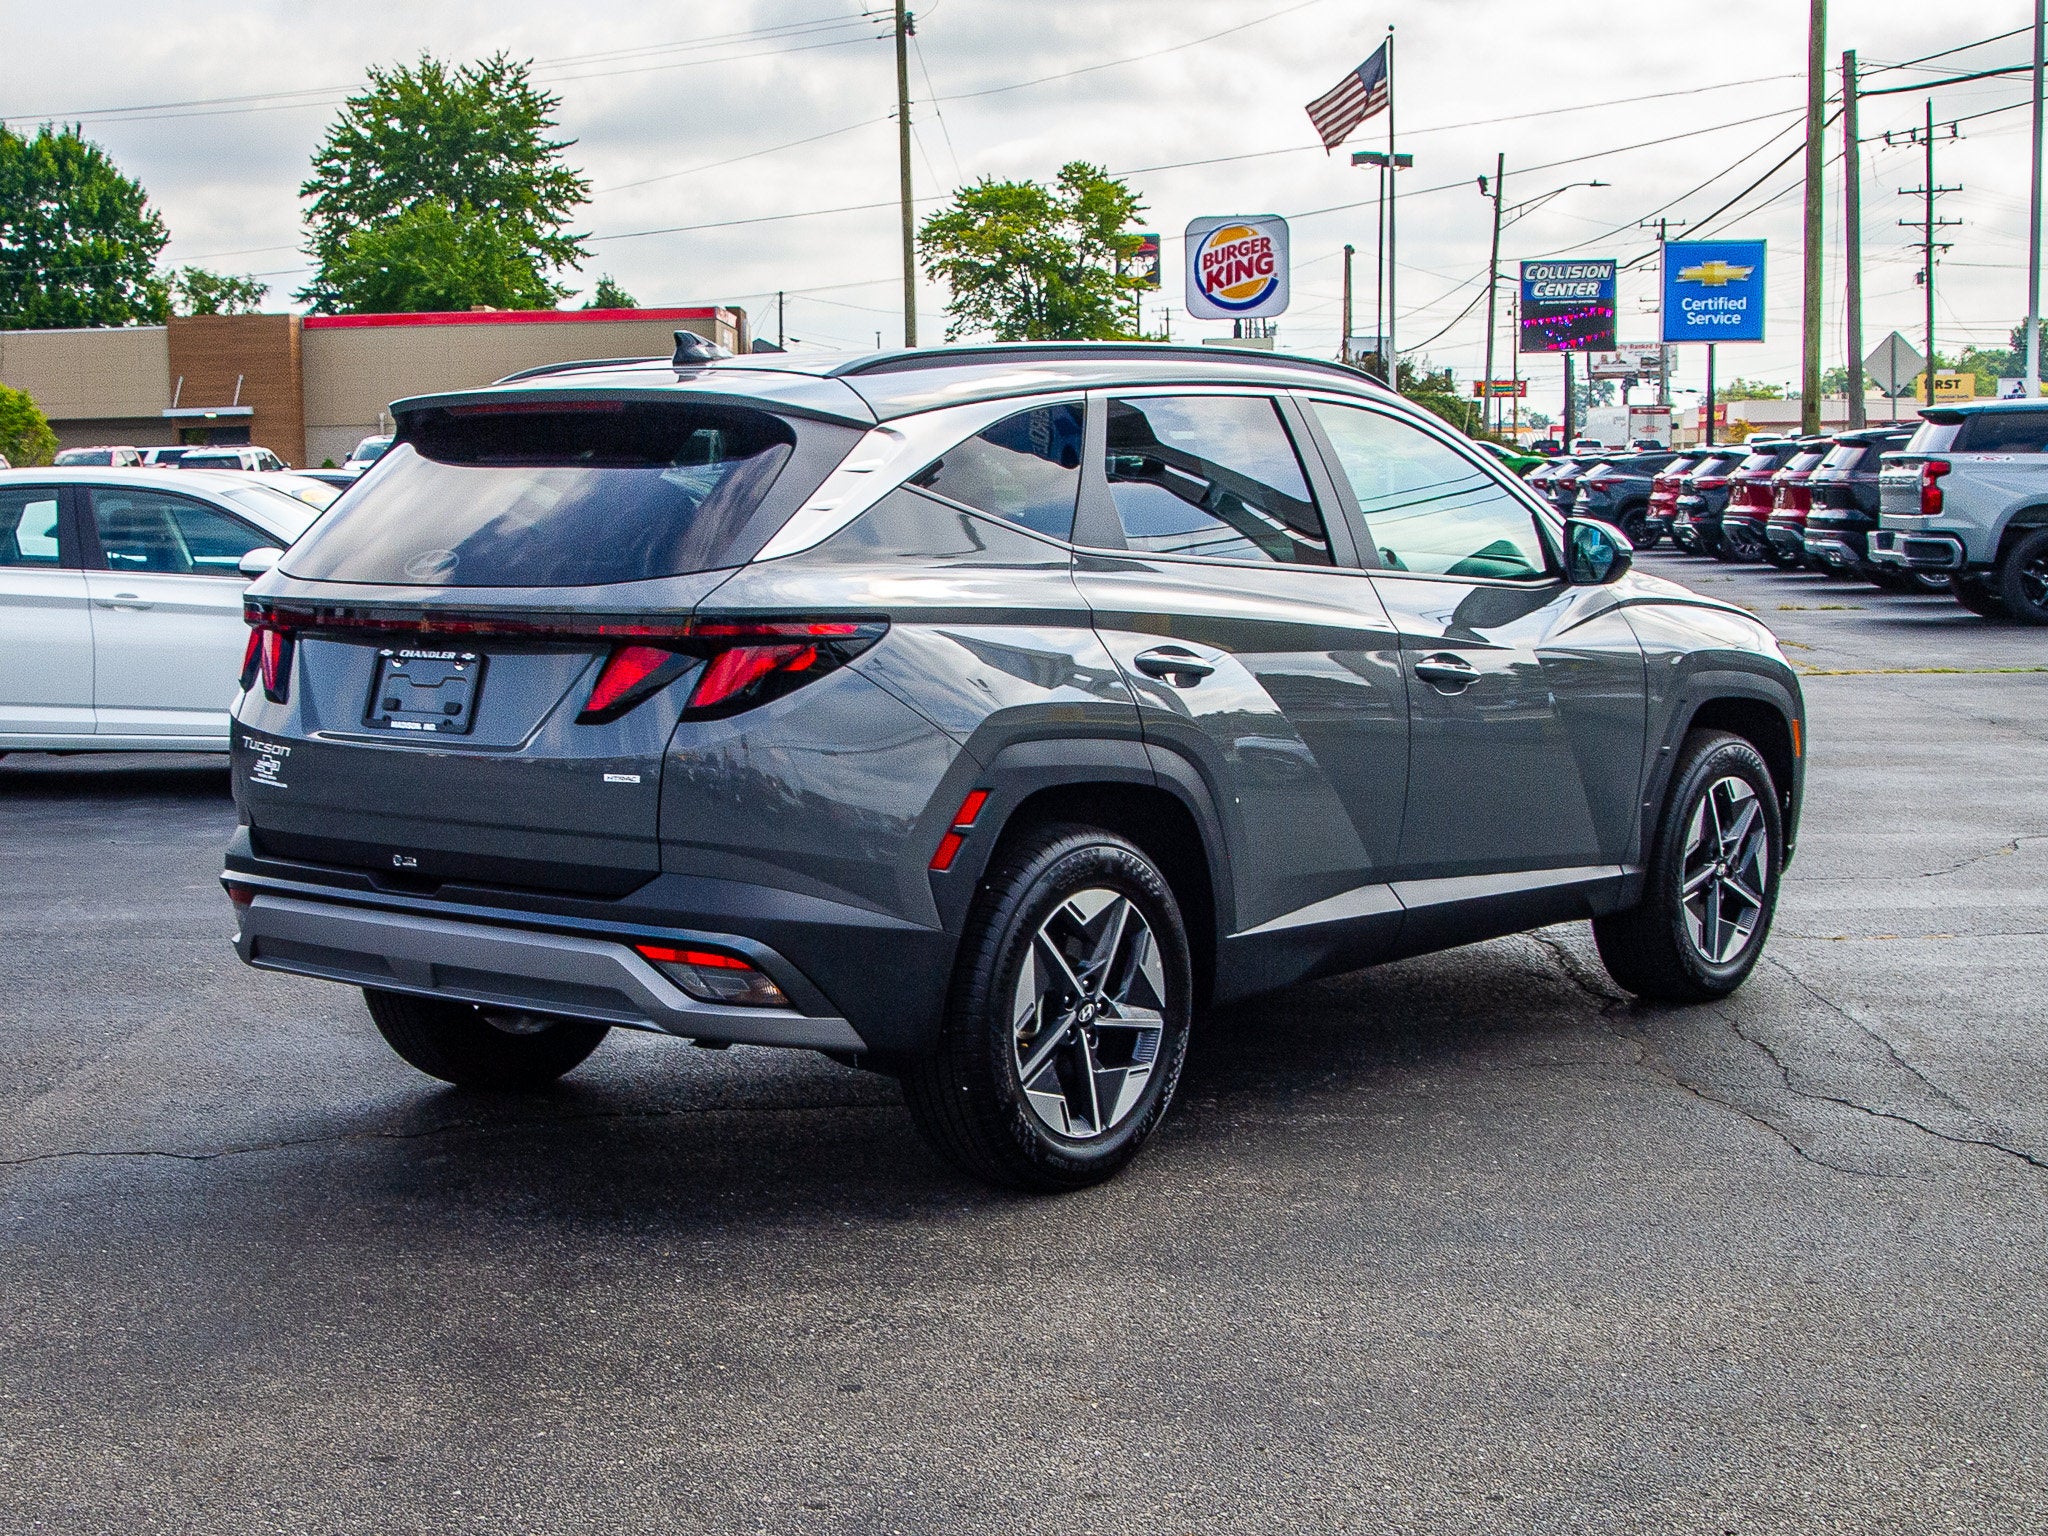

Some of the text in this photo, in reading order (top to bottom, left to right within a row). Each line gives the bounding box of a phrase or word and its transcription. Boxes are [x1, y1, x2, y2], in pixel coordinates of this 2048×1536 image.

[1203, 237, 1271, 270] BURGER
[1206, 252, 1274, 293] KING
[1524, 265, 1611, 279] COLLISION
[1533, 282, 1599, 297] CENTER
[1682, 296, 1747, 311] Certified
[1686, 312, 1742, 325] Service
[399, 649, 456, 659] CHANDLER
[242, 735, 291, 757] TUCSON
